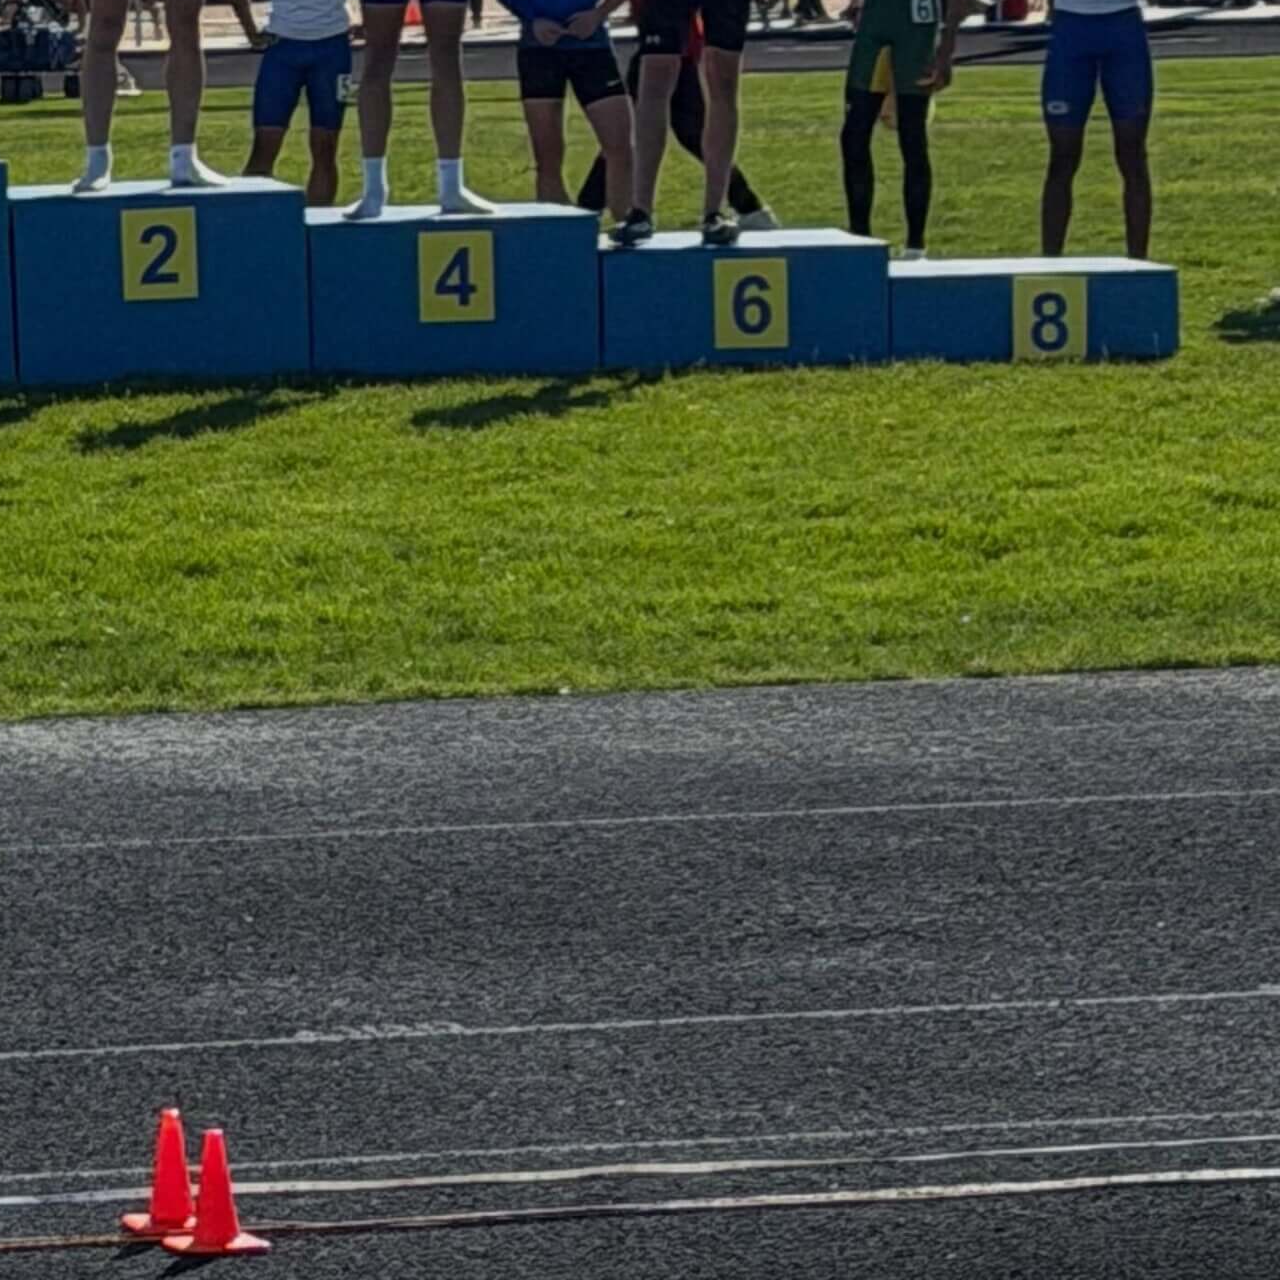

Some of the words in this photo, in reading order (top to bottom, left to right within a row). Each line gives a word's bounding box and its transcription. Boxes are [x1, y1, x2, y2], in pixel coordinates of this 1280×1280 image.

[139, 224, 180, 286] 2
[434, 246, 478, 307] 4
[731, 274, 773, 336] 6
[1030, 291, 1069, 352] 8
